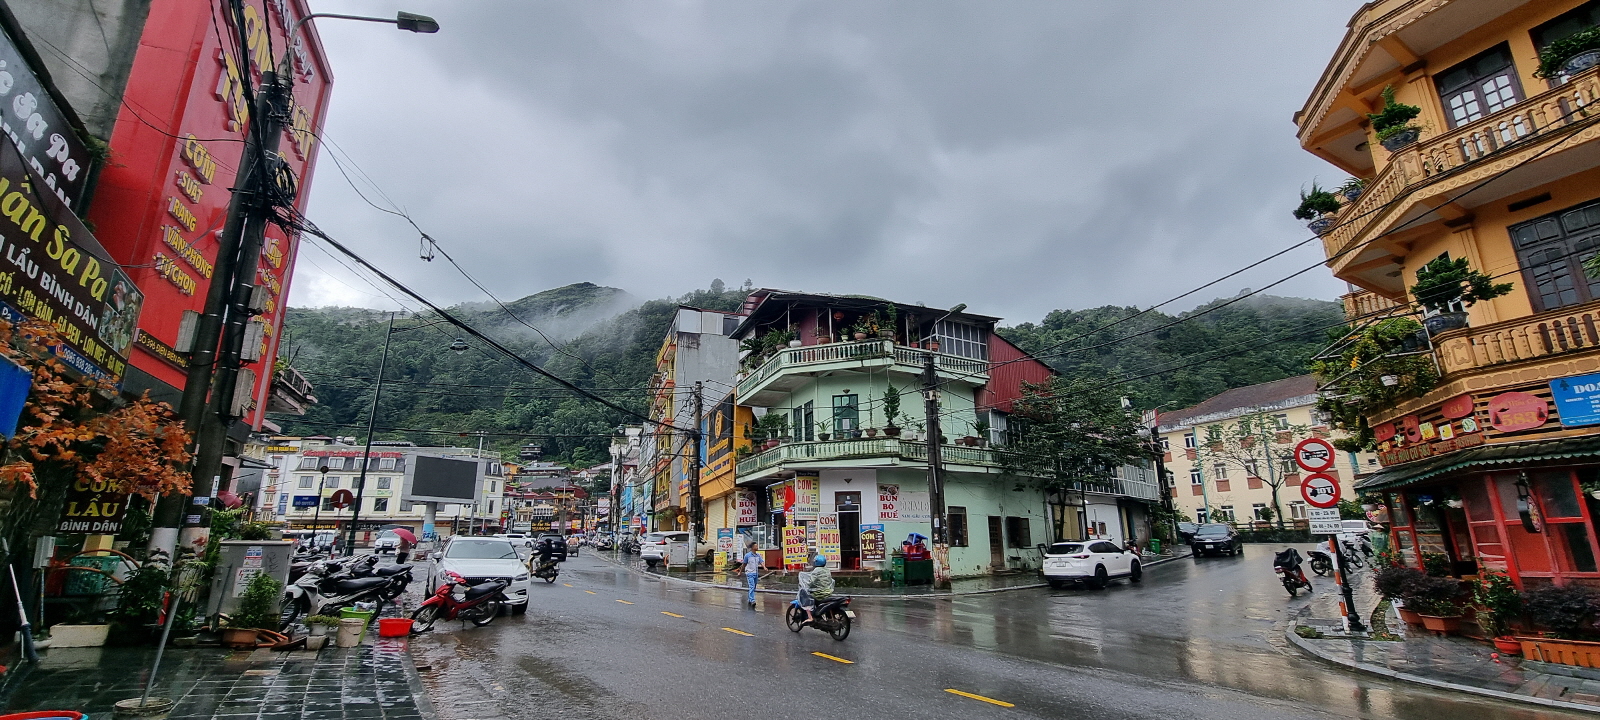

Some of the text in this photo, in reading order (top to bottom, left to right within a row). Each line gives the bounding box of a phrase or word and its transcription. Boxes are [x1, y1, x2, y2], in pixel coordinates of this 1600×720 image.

[12, 92, 49, 141] Sa
[47, 133, 81, 182] Pa
[172, 198, 198, 232] RANG
[45, 224, 82, 276] Sa
[79, 256, 108, 302] Pa
[6, 242, 40, 281] LẨU
[39, 271, 76, 311] BÌNH
[74, 302, 100, 331] DÂN
[1501, 411, 1538, 427] 583
[66, 493, 120, 517] LẨU
[880, 494, 898, 502] BÚN
[882, 502, 894, 510] BÒ
[739, 514, 756, 523] HUẾ
[880, 510, 898, 519] HUẾ
[59, 519, 119, 532] BÌNH DÂN
[786, 528, 805, 537] BÚN
